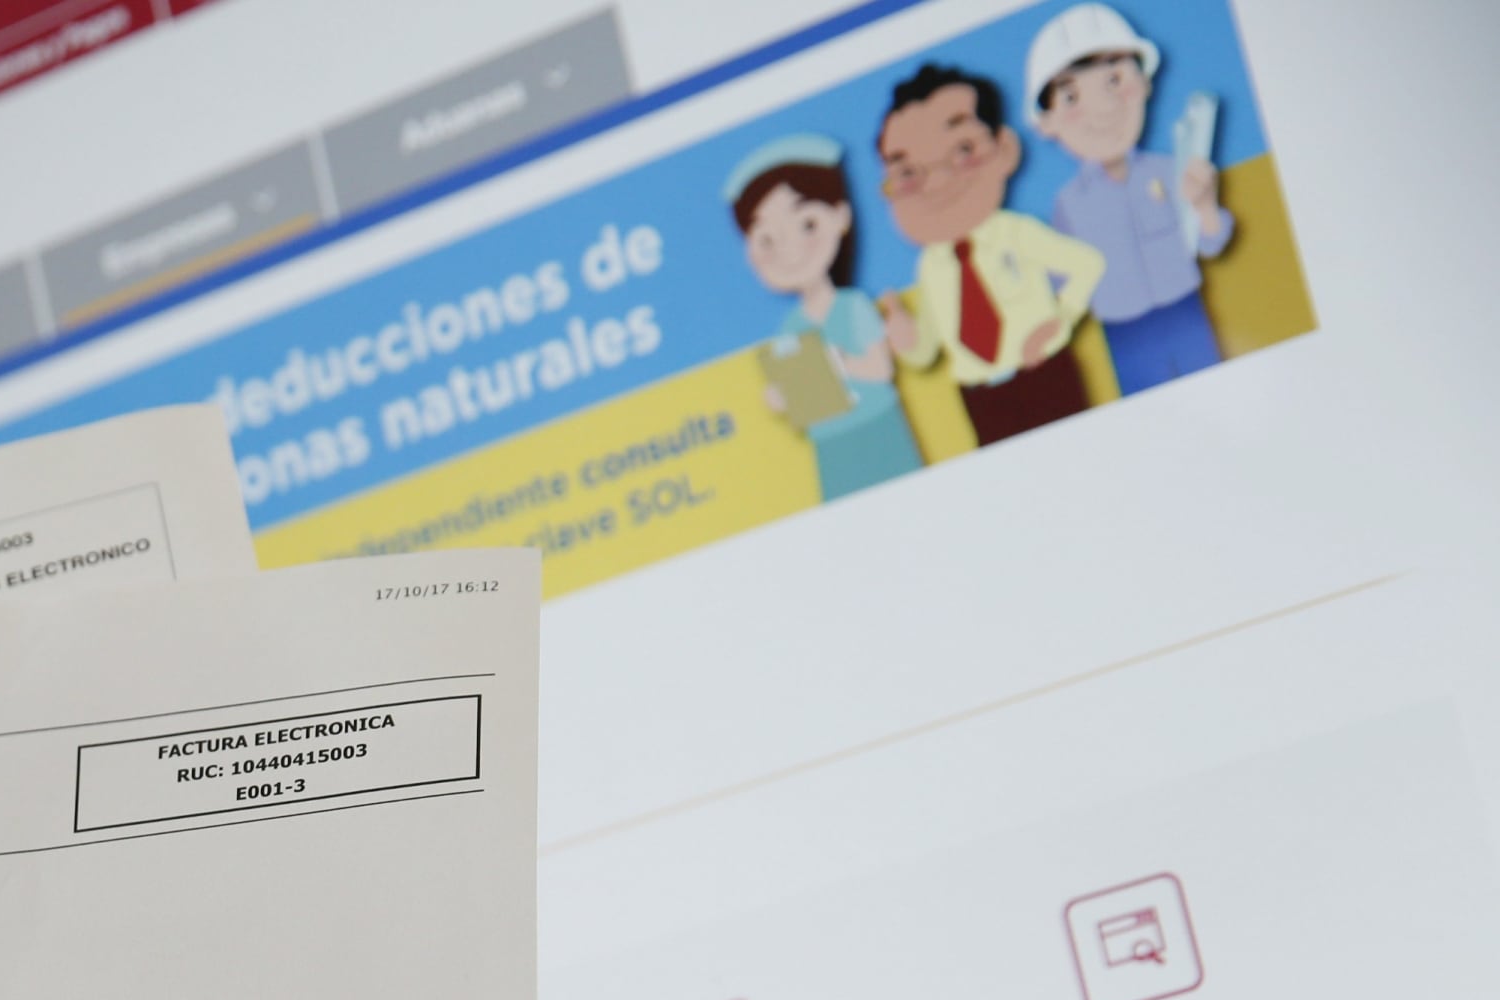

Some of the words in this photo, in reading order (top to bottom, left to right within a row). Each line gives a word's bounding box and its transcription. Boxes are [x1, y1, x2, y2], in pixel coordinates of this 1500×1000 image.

[581, 223, 664, 291] de
[381, 305, 662, 450] naturales
[580, 410, 736, 489] consulta
[6, 538, 150, 587] ELECTRONICO
[376, 583, 449, 600] 17/10/17
[457, 580, 499, 593] 16:12
[158, 735, 248, 759] FACTURA
[254, 714, 395, 747] ELECTRONICA
[177, 763, 224, 783] RUC:
[231, 743, 368, 776] 10440415003
[236, 779, 306, 800] E001-3
